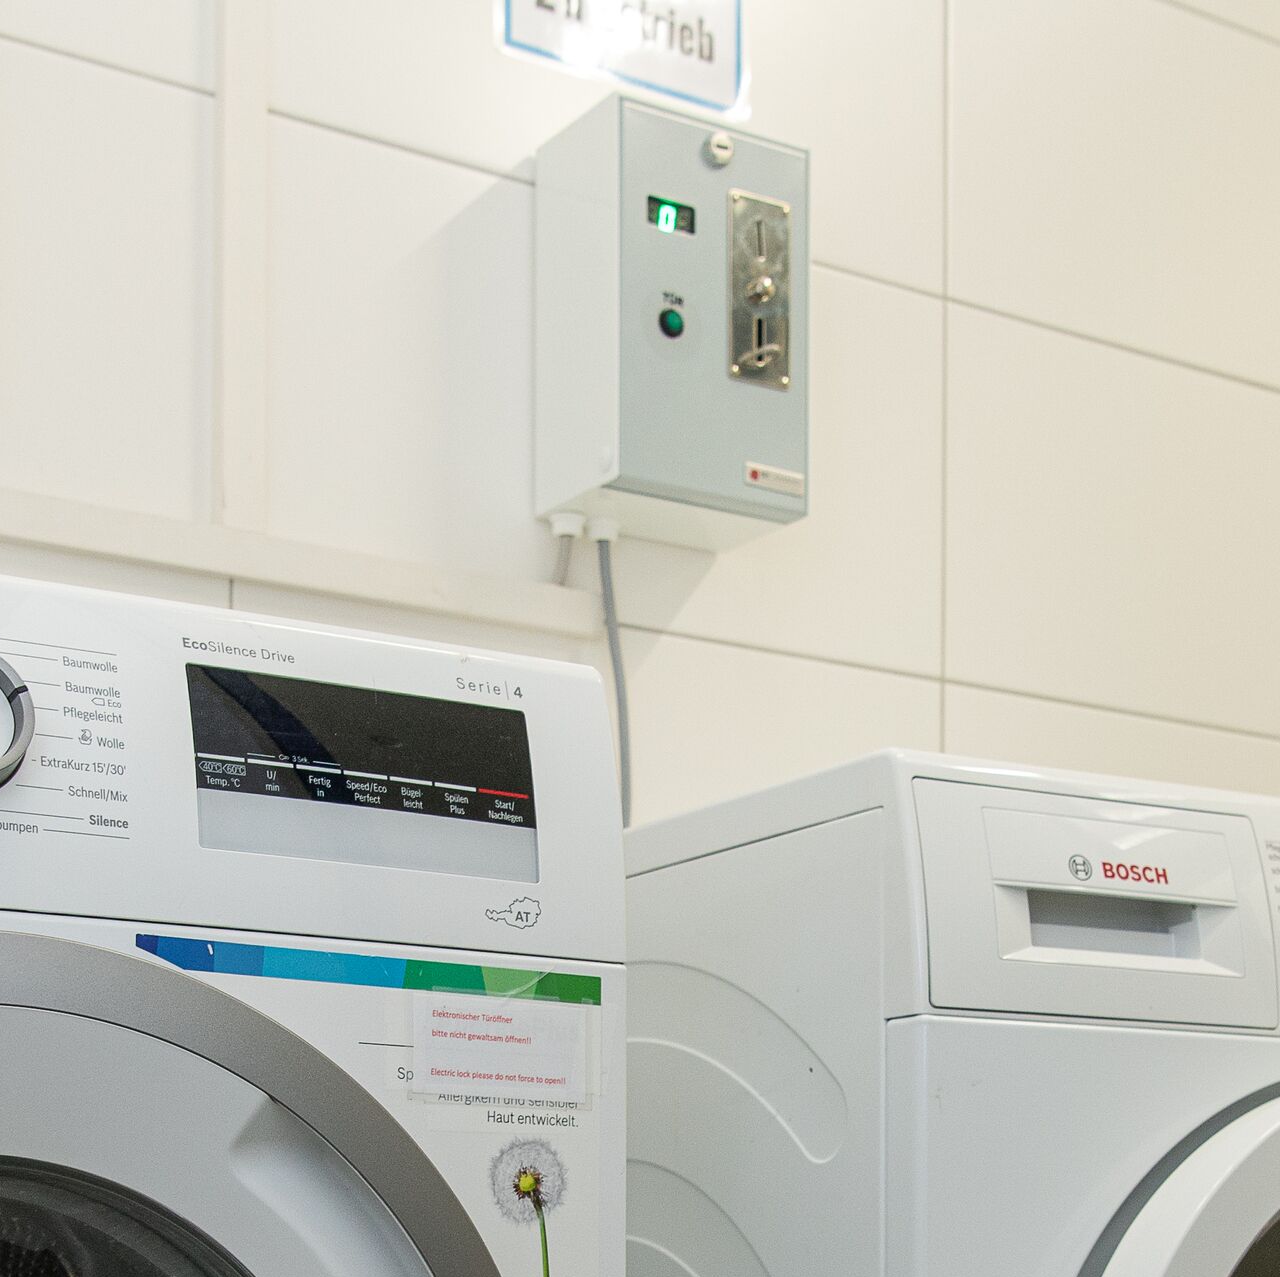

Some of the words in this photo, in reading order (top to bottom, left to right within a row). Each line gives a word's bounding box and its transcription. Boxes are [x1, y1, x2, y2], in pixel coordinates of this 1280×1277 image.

[182, 637, 257, 659] EcoSilence
[261, 648, 296, 664] Drive
[62, 656, 118, 673] Baumwolle
[65, 681, 121, 698] Baumwolle
[456, 677, 501, 696] Serie
[513, 687, 524, 698] 4
[107, 699, 122, 708] Eco
[63, 706, 124, 724] Pflegeleicht
[97, 736, 125, 750] Wolle
[40, 756, 90, 772] ExtraKurz
[93, 762, 127, 776] 15'/30'
[206, 775, 230, 787] Temp.
[231, 777, 241, 788] °C
[265, 782, 280, 792] min
[308, 775, 331, 788] Fertig
[345, 779, 388, 793] Speed/Eco
[68, 785, 128, 802] Schnell/Mix
[317, 789, 325, 797] in
[354, 792, 381, 805] Perfect
[444, 792, 469, 805] Spülen
[403, 798, 424, 810] leicht
[450, 804, 465, 815] Plus
[494, 799, 515, 811] Start/
[89, 814, 129, 829] Silence
[488, 810, 523, 823] Nachlegen
[1102, 862, 1169, 885] BOSCH
[515, 911, 531, 922] AT
[432, 1009, 480, 1021] Elektronischer
[482, 1014, 513, 1024] Türöffner
[431, 1029, 448, 1038] bitte
[449, 1030, 467, 1039] nicht
[468, 1033, 504, 1042] gewaltsam
[431, 1067, 455, 1077] Electric
[457, 1069, 471, 1078] lock
[472, 1070, 493, 1080] please
[495, 1072, 504, 1080] do
[505, 1073, 516, 1081] not
[517, 1074, 535, 1083] force
[536, 1076, 544, 1084] to
[487, 1110, 515, 1125] Haut
[517, 1112, 579, 1127] entwickelt.
